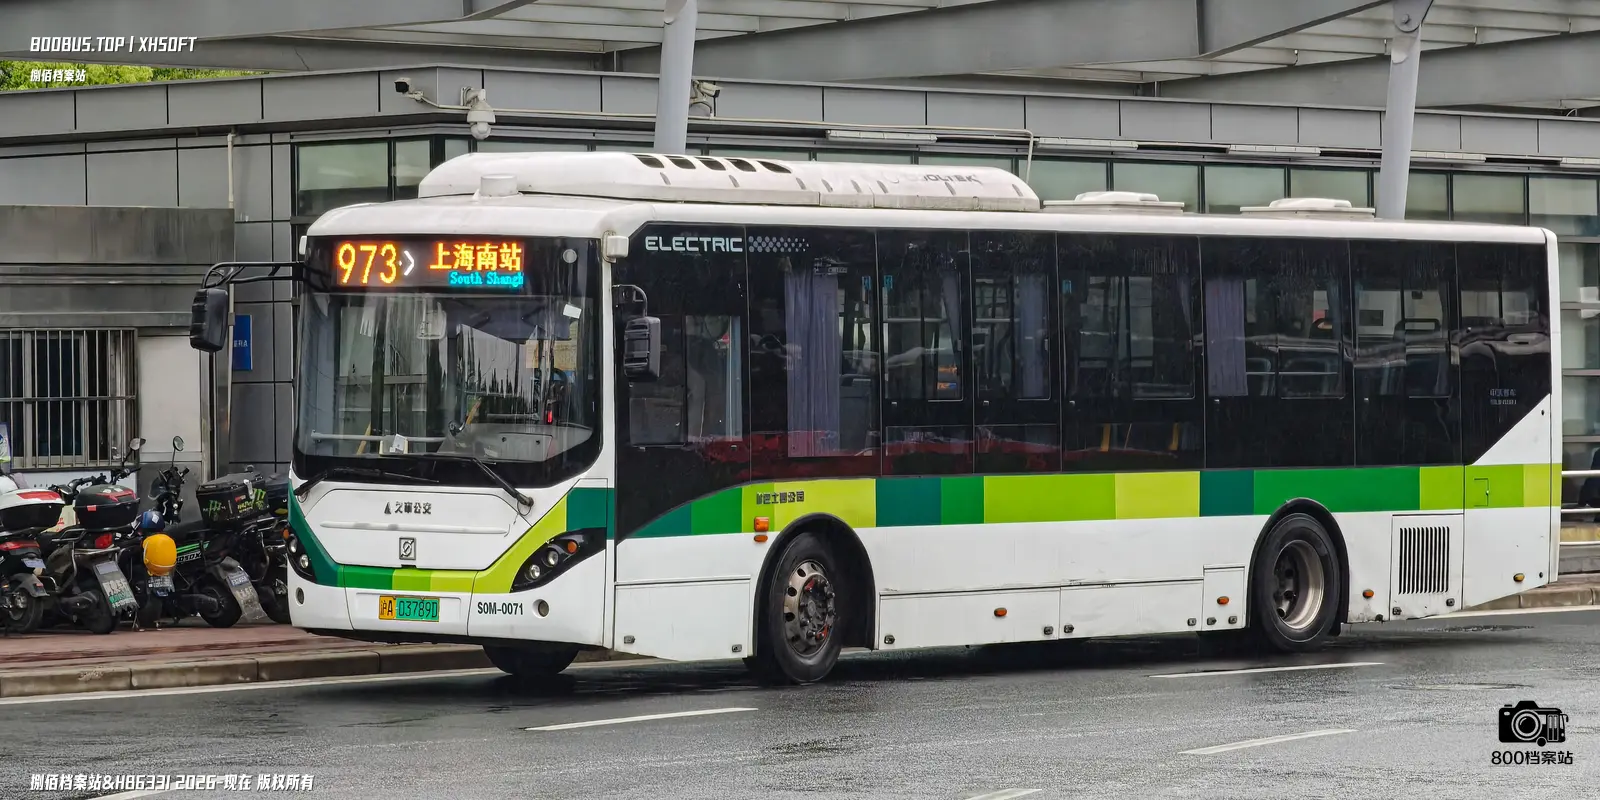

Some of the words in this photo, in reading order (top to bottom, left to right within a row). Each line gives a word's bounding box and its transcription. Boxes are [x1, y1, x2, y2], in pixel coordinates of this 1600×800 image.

[645, 236, 743, 252] ELECTRIC
[338, 243, 397, 284] 973
[429, 242, 522, 271] 上海南站
[450, 272, 482, 285] South
